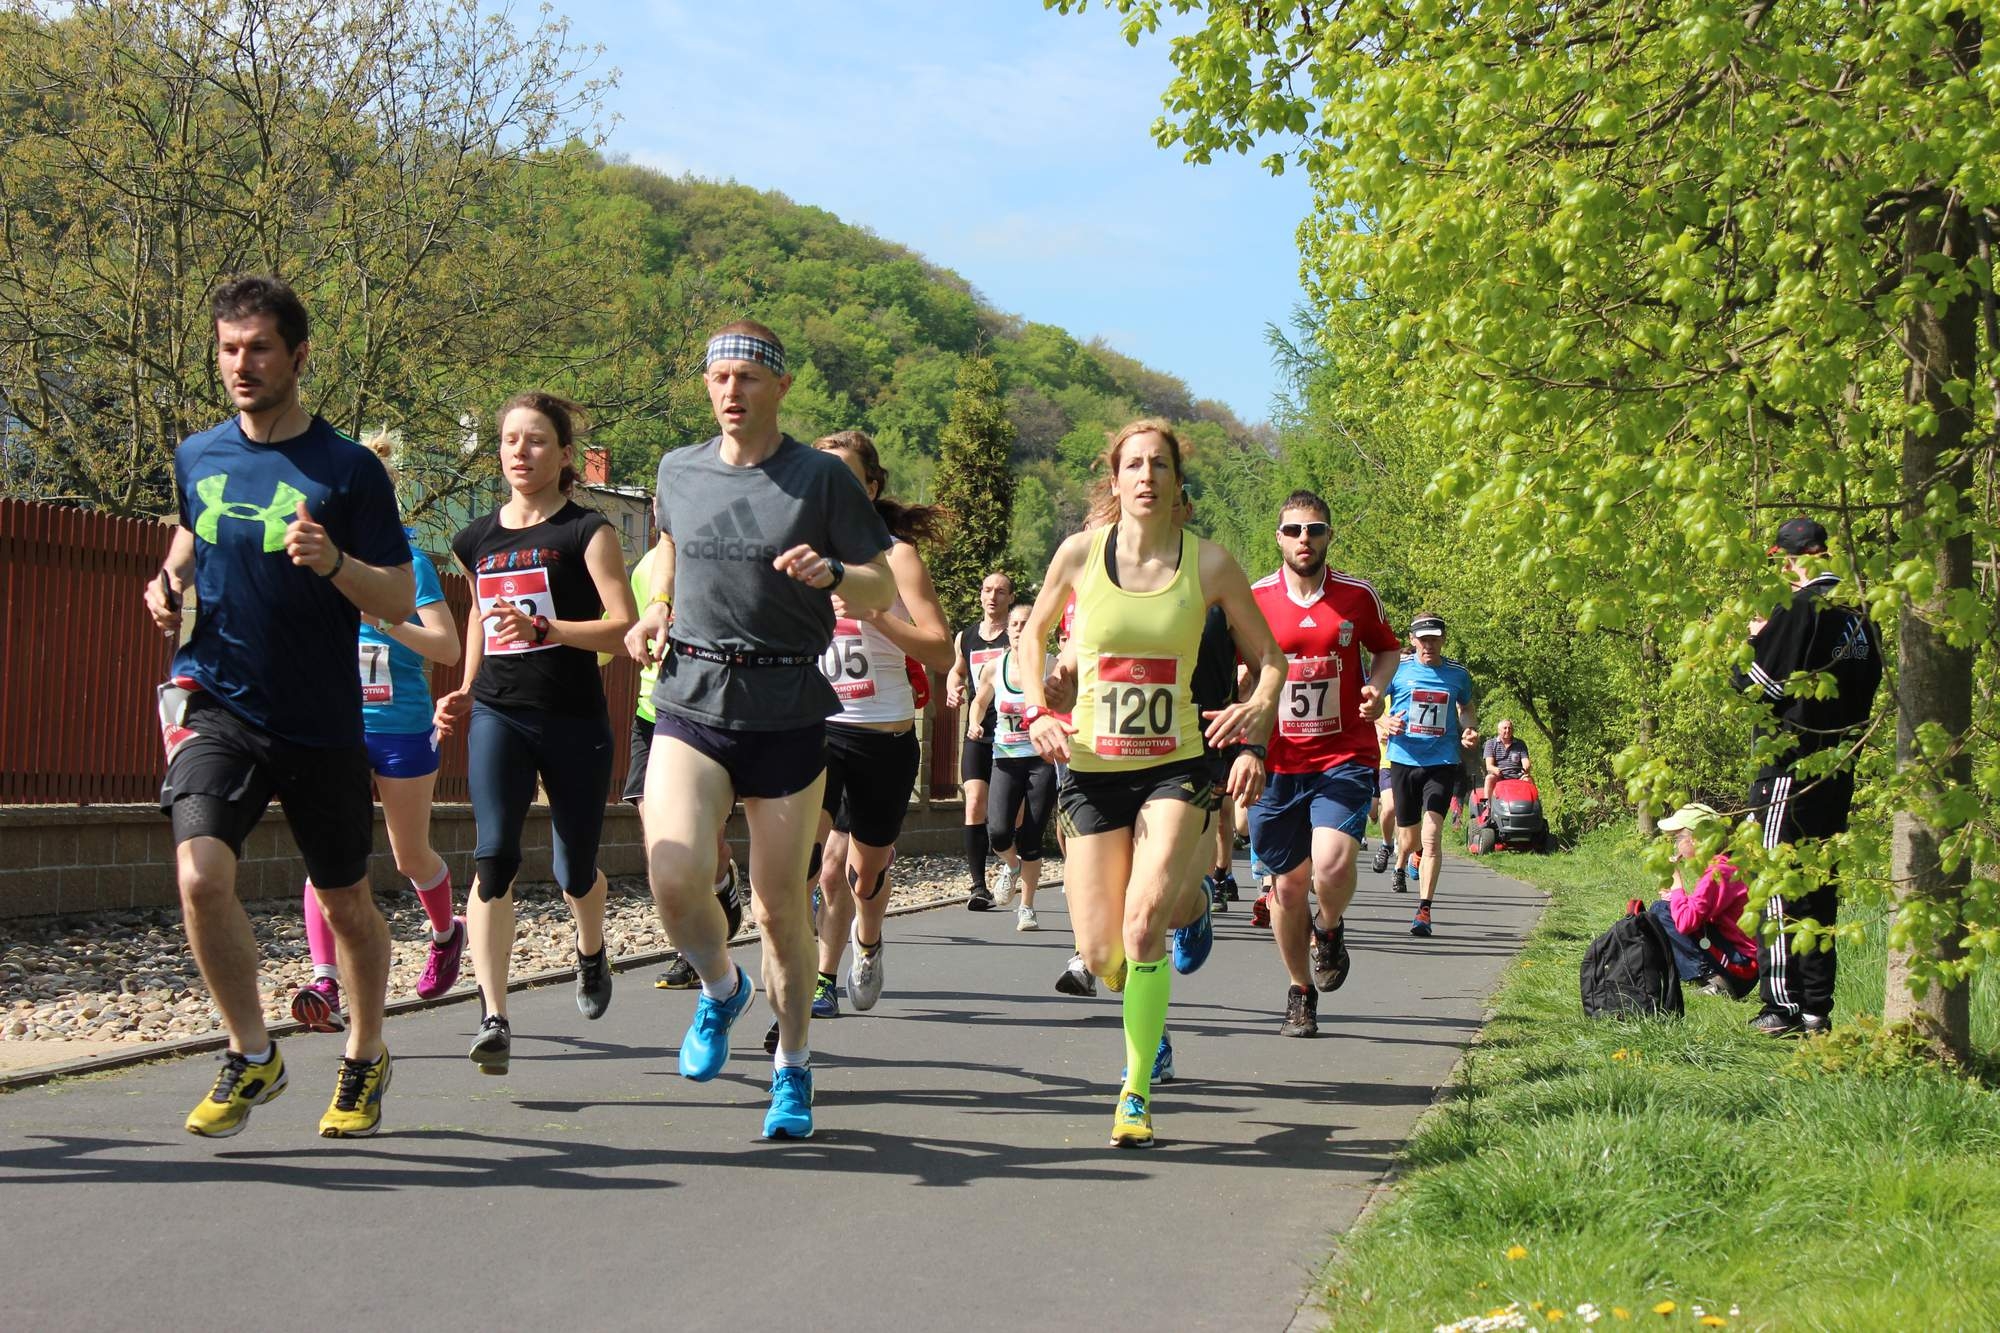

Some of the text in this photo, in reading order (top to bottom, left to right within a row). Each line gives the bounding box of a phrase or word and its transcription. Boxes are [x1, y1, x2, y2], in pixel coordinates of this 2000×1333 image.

[683, 536, 778, 562] adidas
[1101, 686, 1173, 735] 120
[1290, 682, 1329, 718] 57
[1418, 703, 1438, 726] 71
[1114, 738, 1171, 748] LOKOMOTIVA
[1120, 747, 1151, 755] MUMIE
